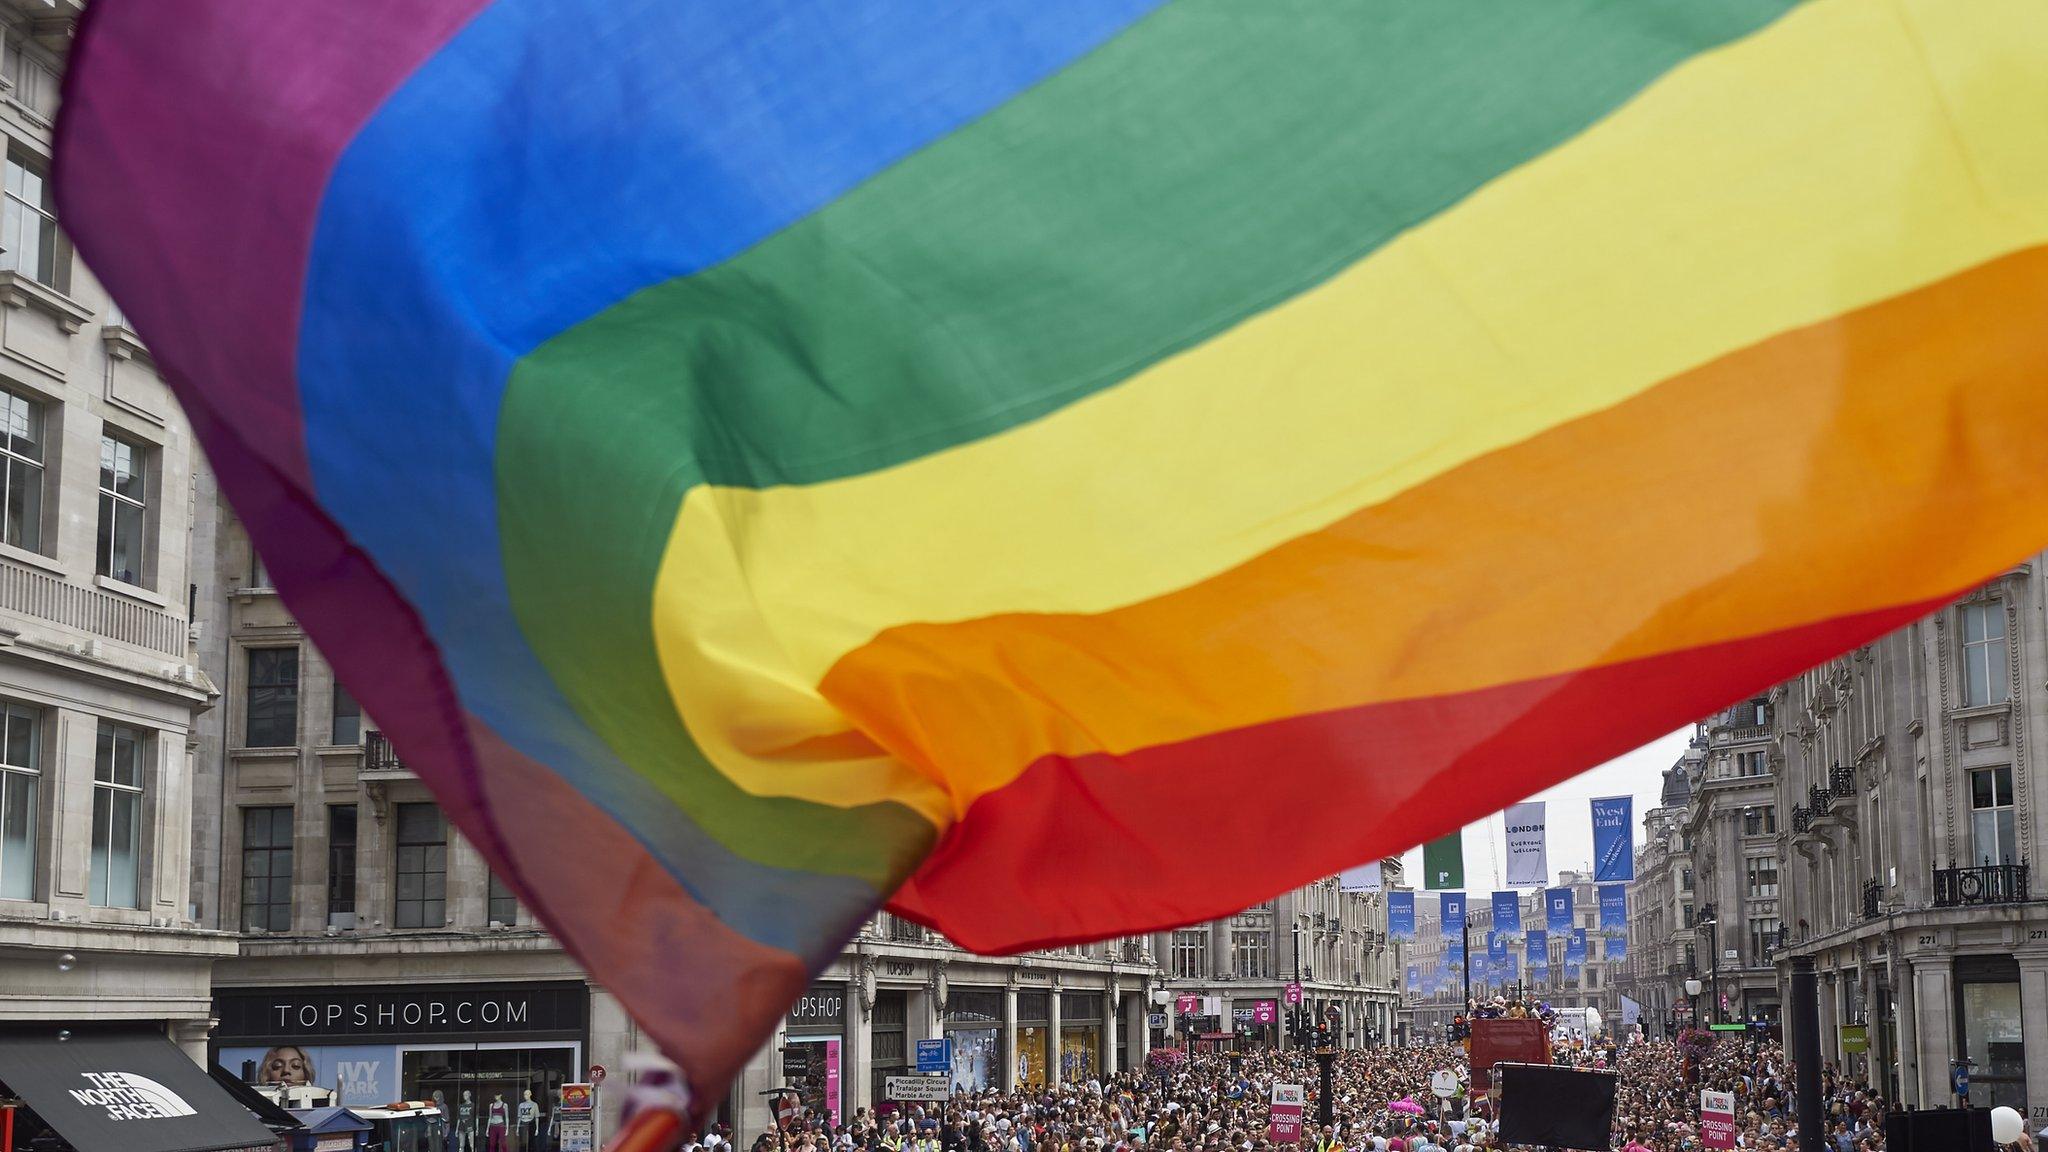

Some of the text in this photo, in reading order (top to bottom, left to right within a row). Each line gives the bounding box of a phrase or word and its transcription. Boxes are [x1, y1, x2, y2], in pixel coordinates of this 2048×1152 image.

[1595, 807, 1623, 816] West
[1596, 817, 1622, 827] End.
[1506, 824, 1545, 833] LONDON
[2030, 930, 2047, 939] 271
[1920, 936, 1936, 944] 271
[886, 962, 915, 976] TOPSHOP
[792, 997, 842, 1017] OPSHOP
[274, 1001, 528, 1027] TOPSHOP.COM
[1233, 1009, 1256, 1017] EZEN
[338, 1061, 380, 1081] IVY
[591, 1070, 603, 1078] RF
[81, 1072, 127, 1089] THE
[69, 1087, 148, 1105] NORTH
[106, 1103, 164, 1120] FACE
[1271, 1114, 1300, 1123] CROSSING
[1276, 1124, 1294, 1133] POINT
[1702, 1120, 1733, 1132] CROSSING
[1709, 1131, 1727, 1141] POINT
